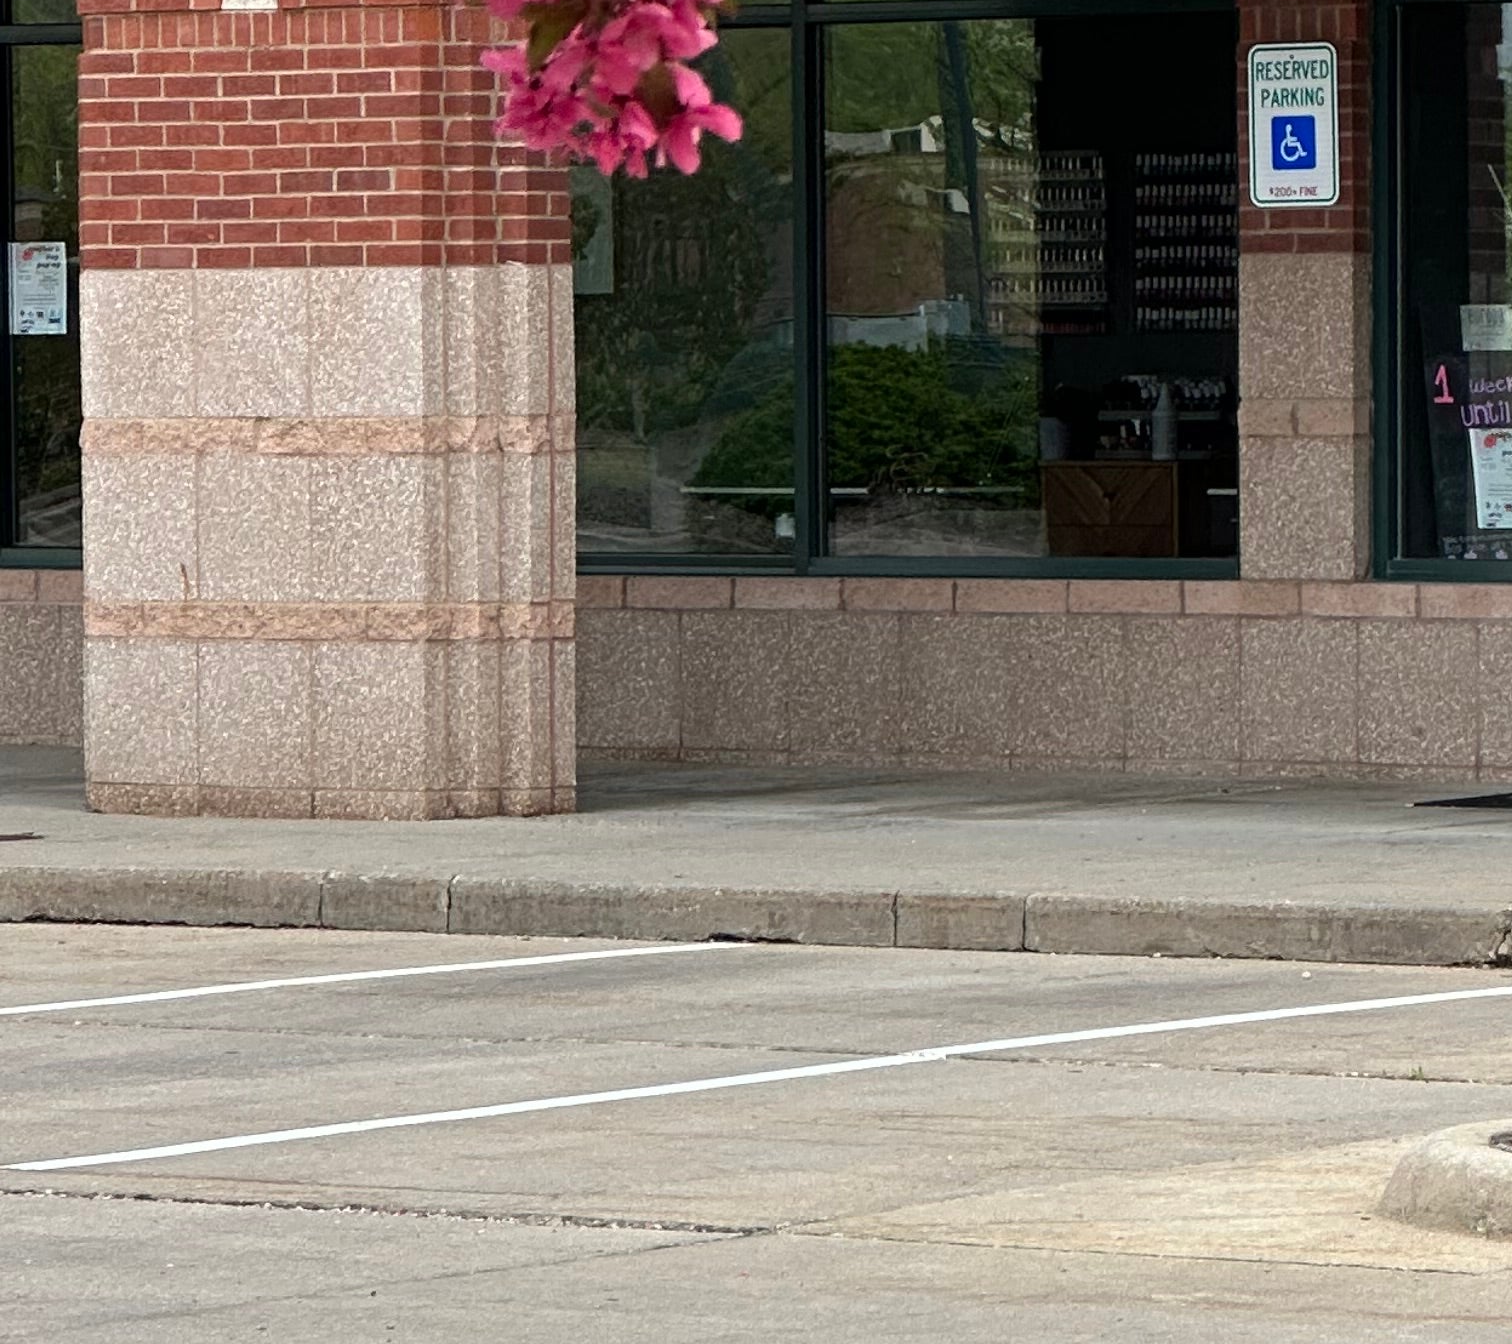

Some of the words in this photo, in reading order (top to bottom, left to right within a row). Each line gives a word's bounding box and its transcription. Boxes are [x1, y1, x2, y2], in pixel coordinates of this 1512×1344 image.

[1255, 59, 1330, 81] RESERVED
[1261, 87, 1325, 108] PARKING
[1299, 186, 1318, 196] FINE
[1434, 364, 1454, 403] 1
